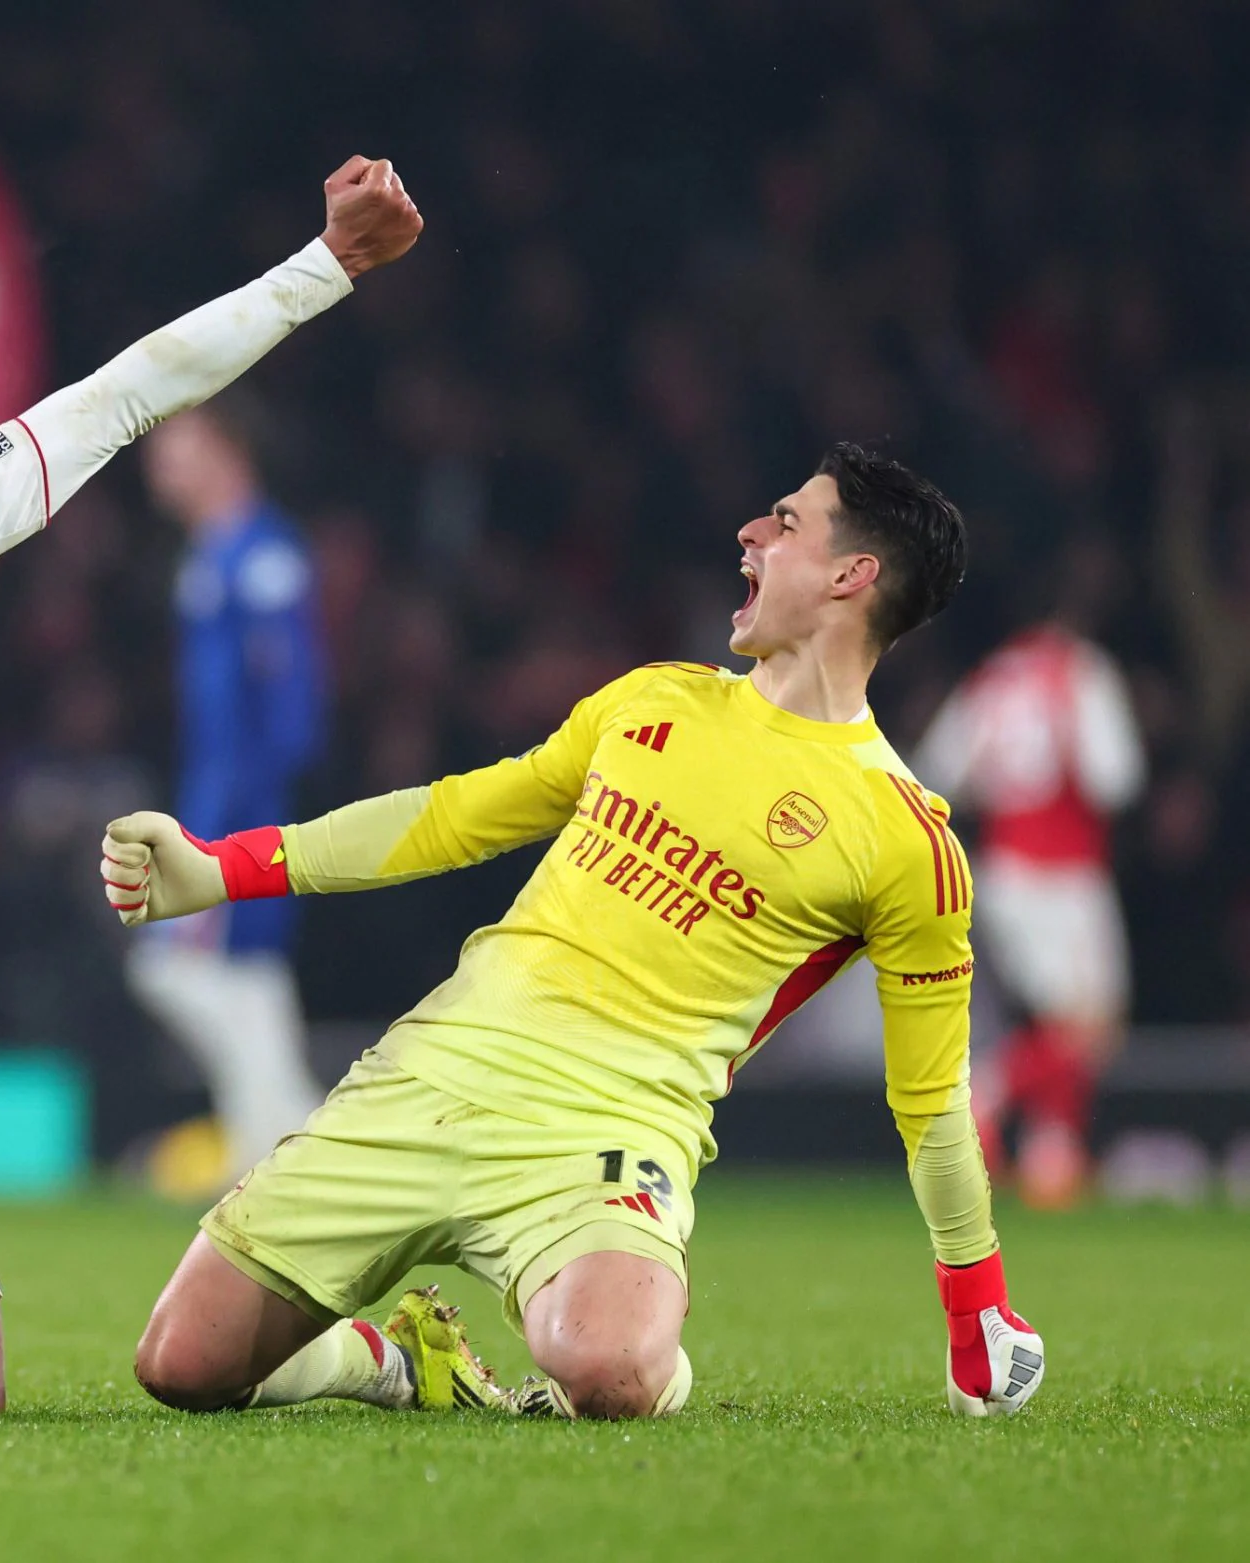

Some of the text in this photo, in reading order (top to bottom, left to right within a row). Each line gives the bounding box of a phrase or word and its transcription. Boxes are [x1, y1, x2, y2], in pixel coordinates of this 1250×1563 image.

[576, 771, 766, 920] Emirates
[786, 800, 819, 828] Arsenal
[566, 829, 711, 937] FLY BETTER
